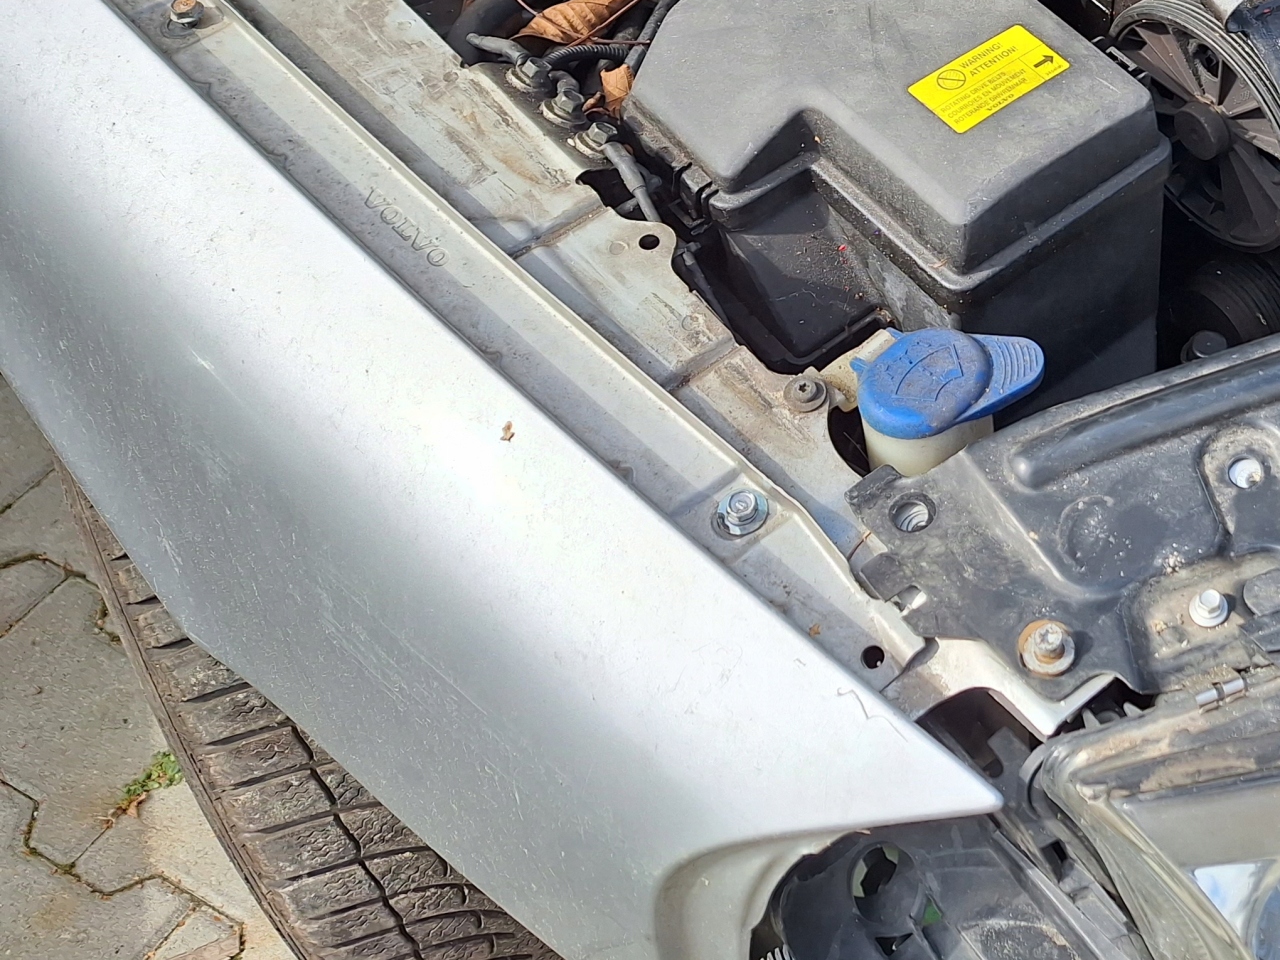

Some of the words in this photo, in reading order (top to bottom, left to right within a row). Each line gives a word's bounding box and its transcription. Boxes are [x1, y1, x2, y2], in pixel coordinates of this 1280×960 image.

[959, 42, 1003, 70] WARNING!
[968, 46, 1018, 77] ATTENTION!
[940, 94, 971, 113] ROTATING
[970, 83, 989, 95] DRIVE
[987, 72, 1007, 85] BELTS
[947, 96, 983, 119] COURROIES
[981, 89, 992, 97] EN
[990, 69, 1026, 92] MOUVEMENT
[986, 93, 1015, 112] VOLVO
[953, 101, 990, 124] ROTERANDE
[364, 186, 450, 267] VOLVO
